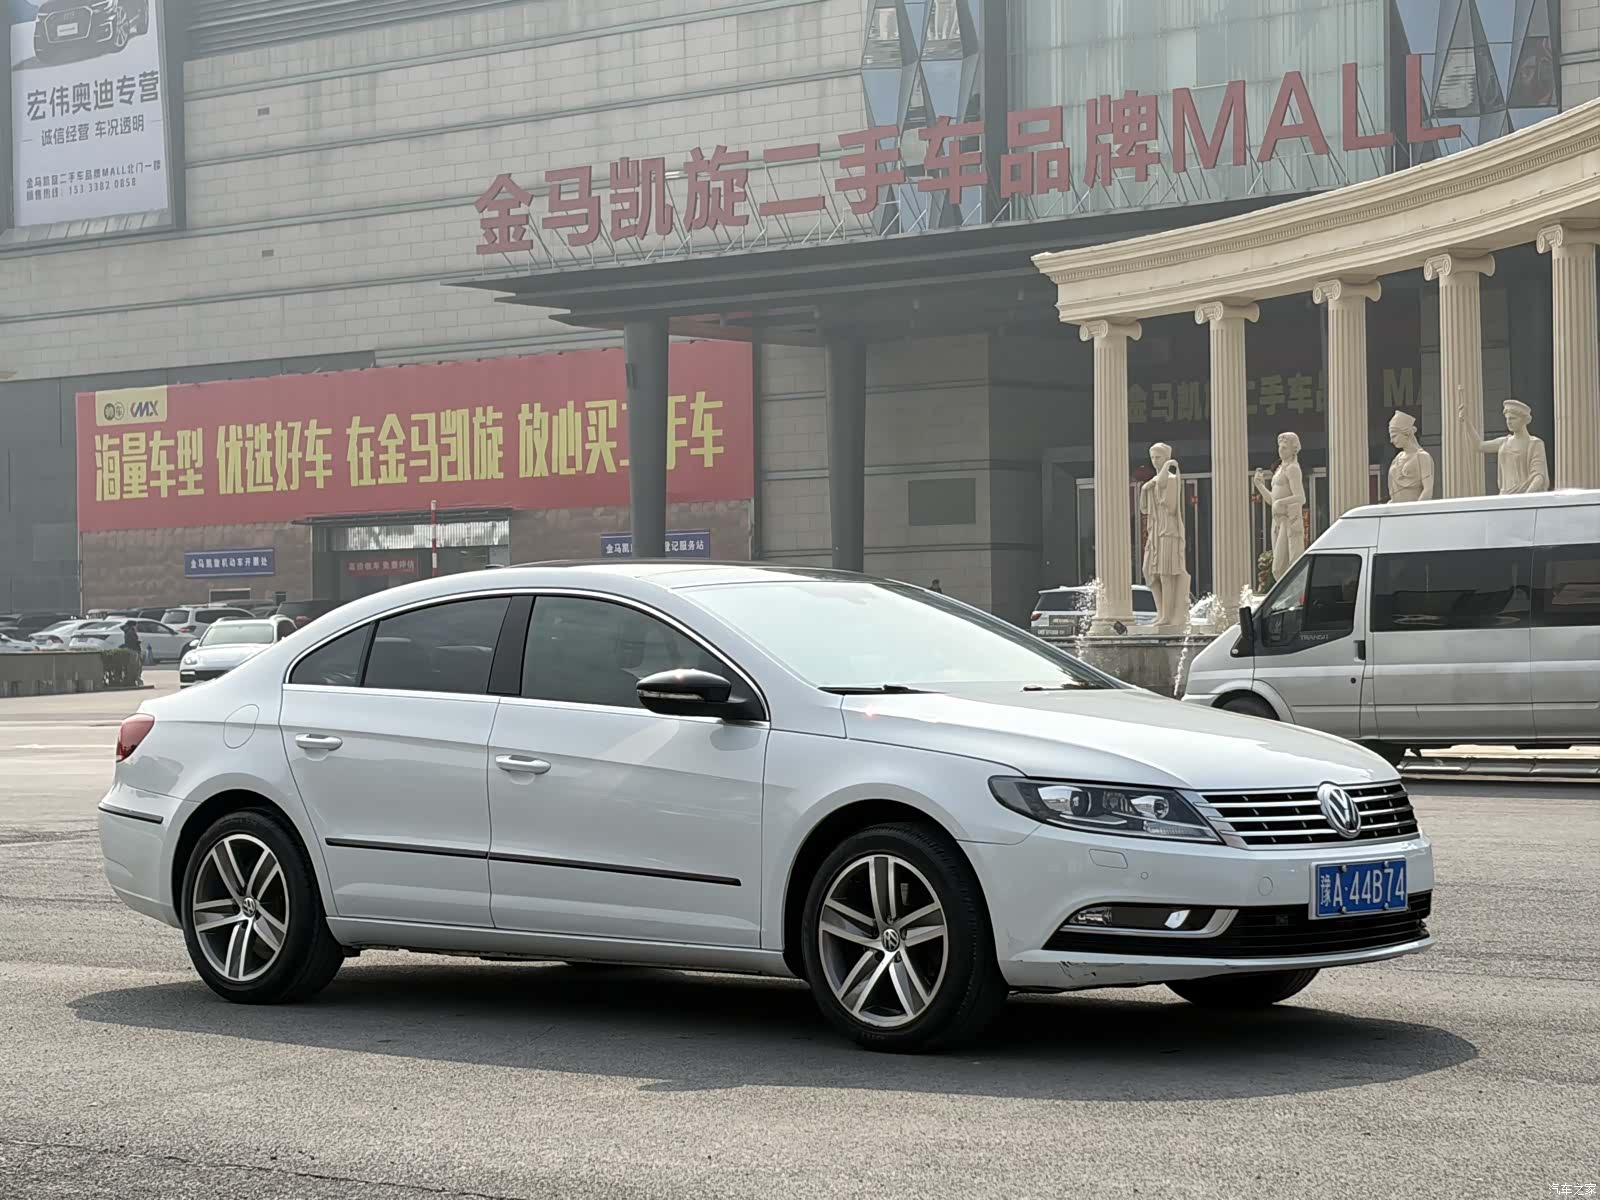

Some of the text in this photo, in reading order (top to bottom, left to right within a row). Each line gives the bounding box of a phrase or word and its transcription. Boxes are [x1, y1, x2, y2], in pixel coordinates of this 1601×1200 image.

[26, 70, 159, 121] 宏伟奥迪专营
[41, 114, 145, 146] 诚信经营 车况透明
[475, 54, 1461, 256] 金马凯旋二手车品牌MALL
[94, 391, 724, 502] 海量车型 优选好车 在金马凯旋 放心买手车
